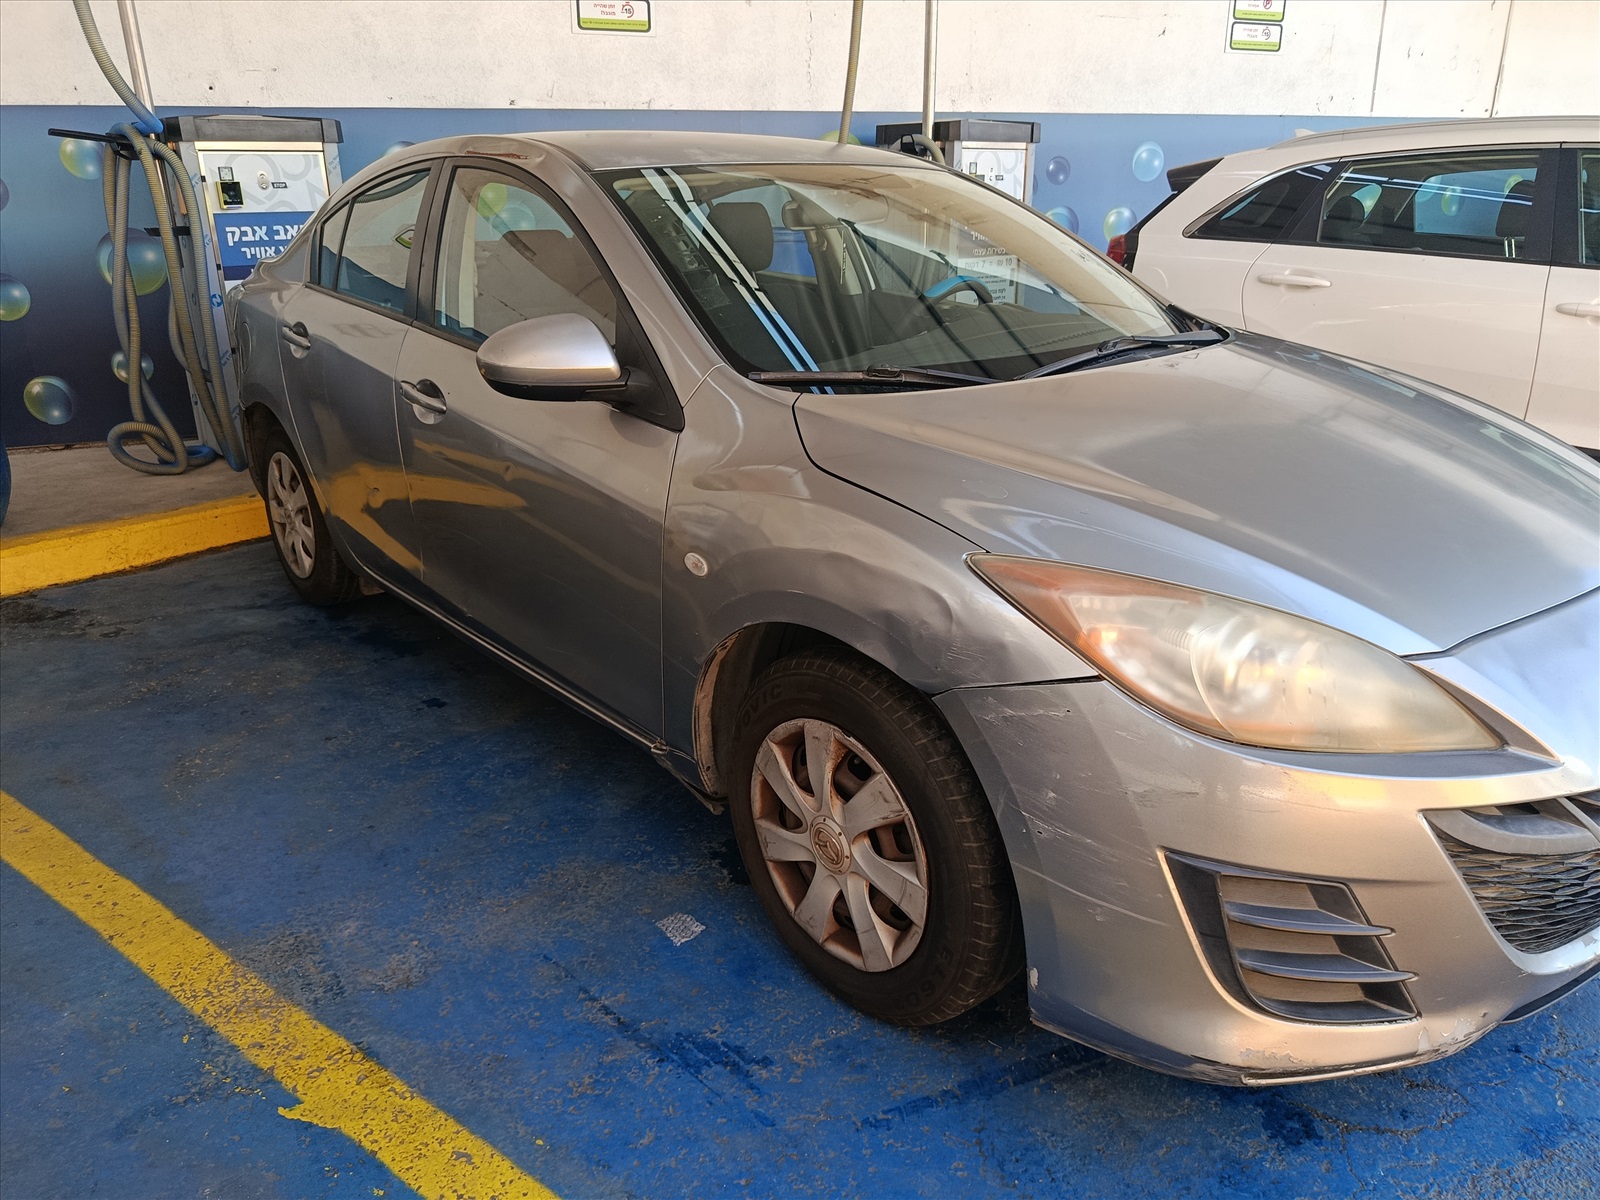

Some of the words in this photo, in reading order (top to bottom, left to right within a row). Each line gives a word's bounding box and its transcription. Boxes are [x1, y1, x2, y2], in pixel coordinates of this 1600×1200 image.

[225, 226, 269, 246] אבק
[273, 225, 302, 241] אב
[240, 246, 276, 259] אוויר
[1005, 258, 1013, 266] 10
